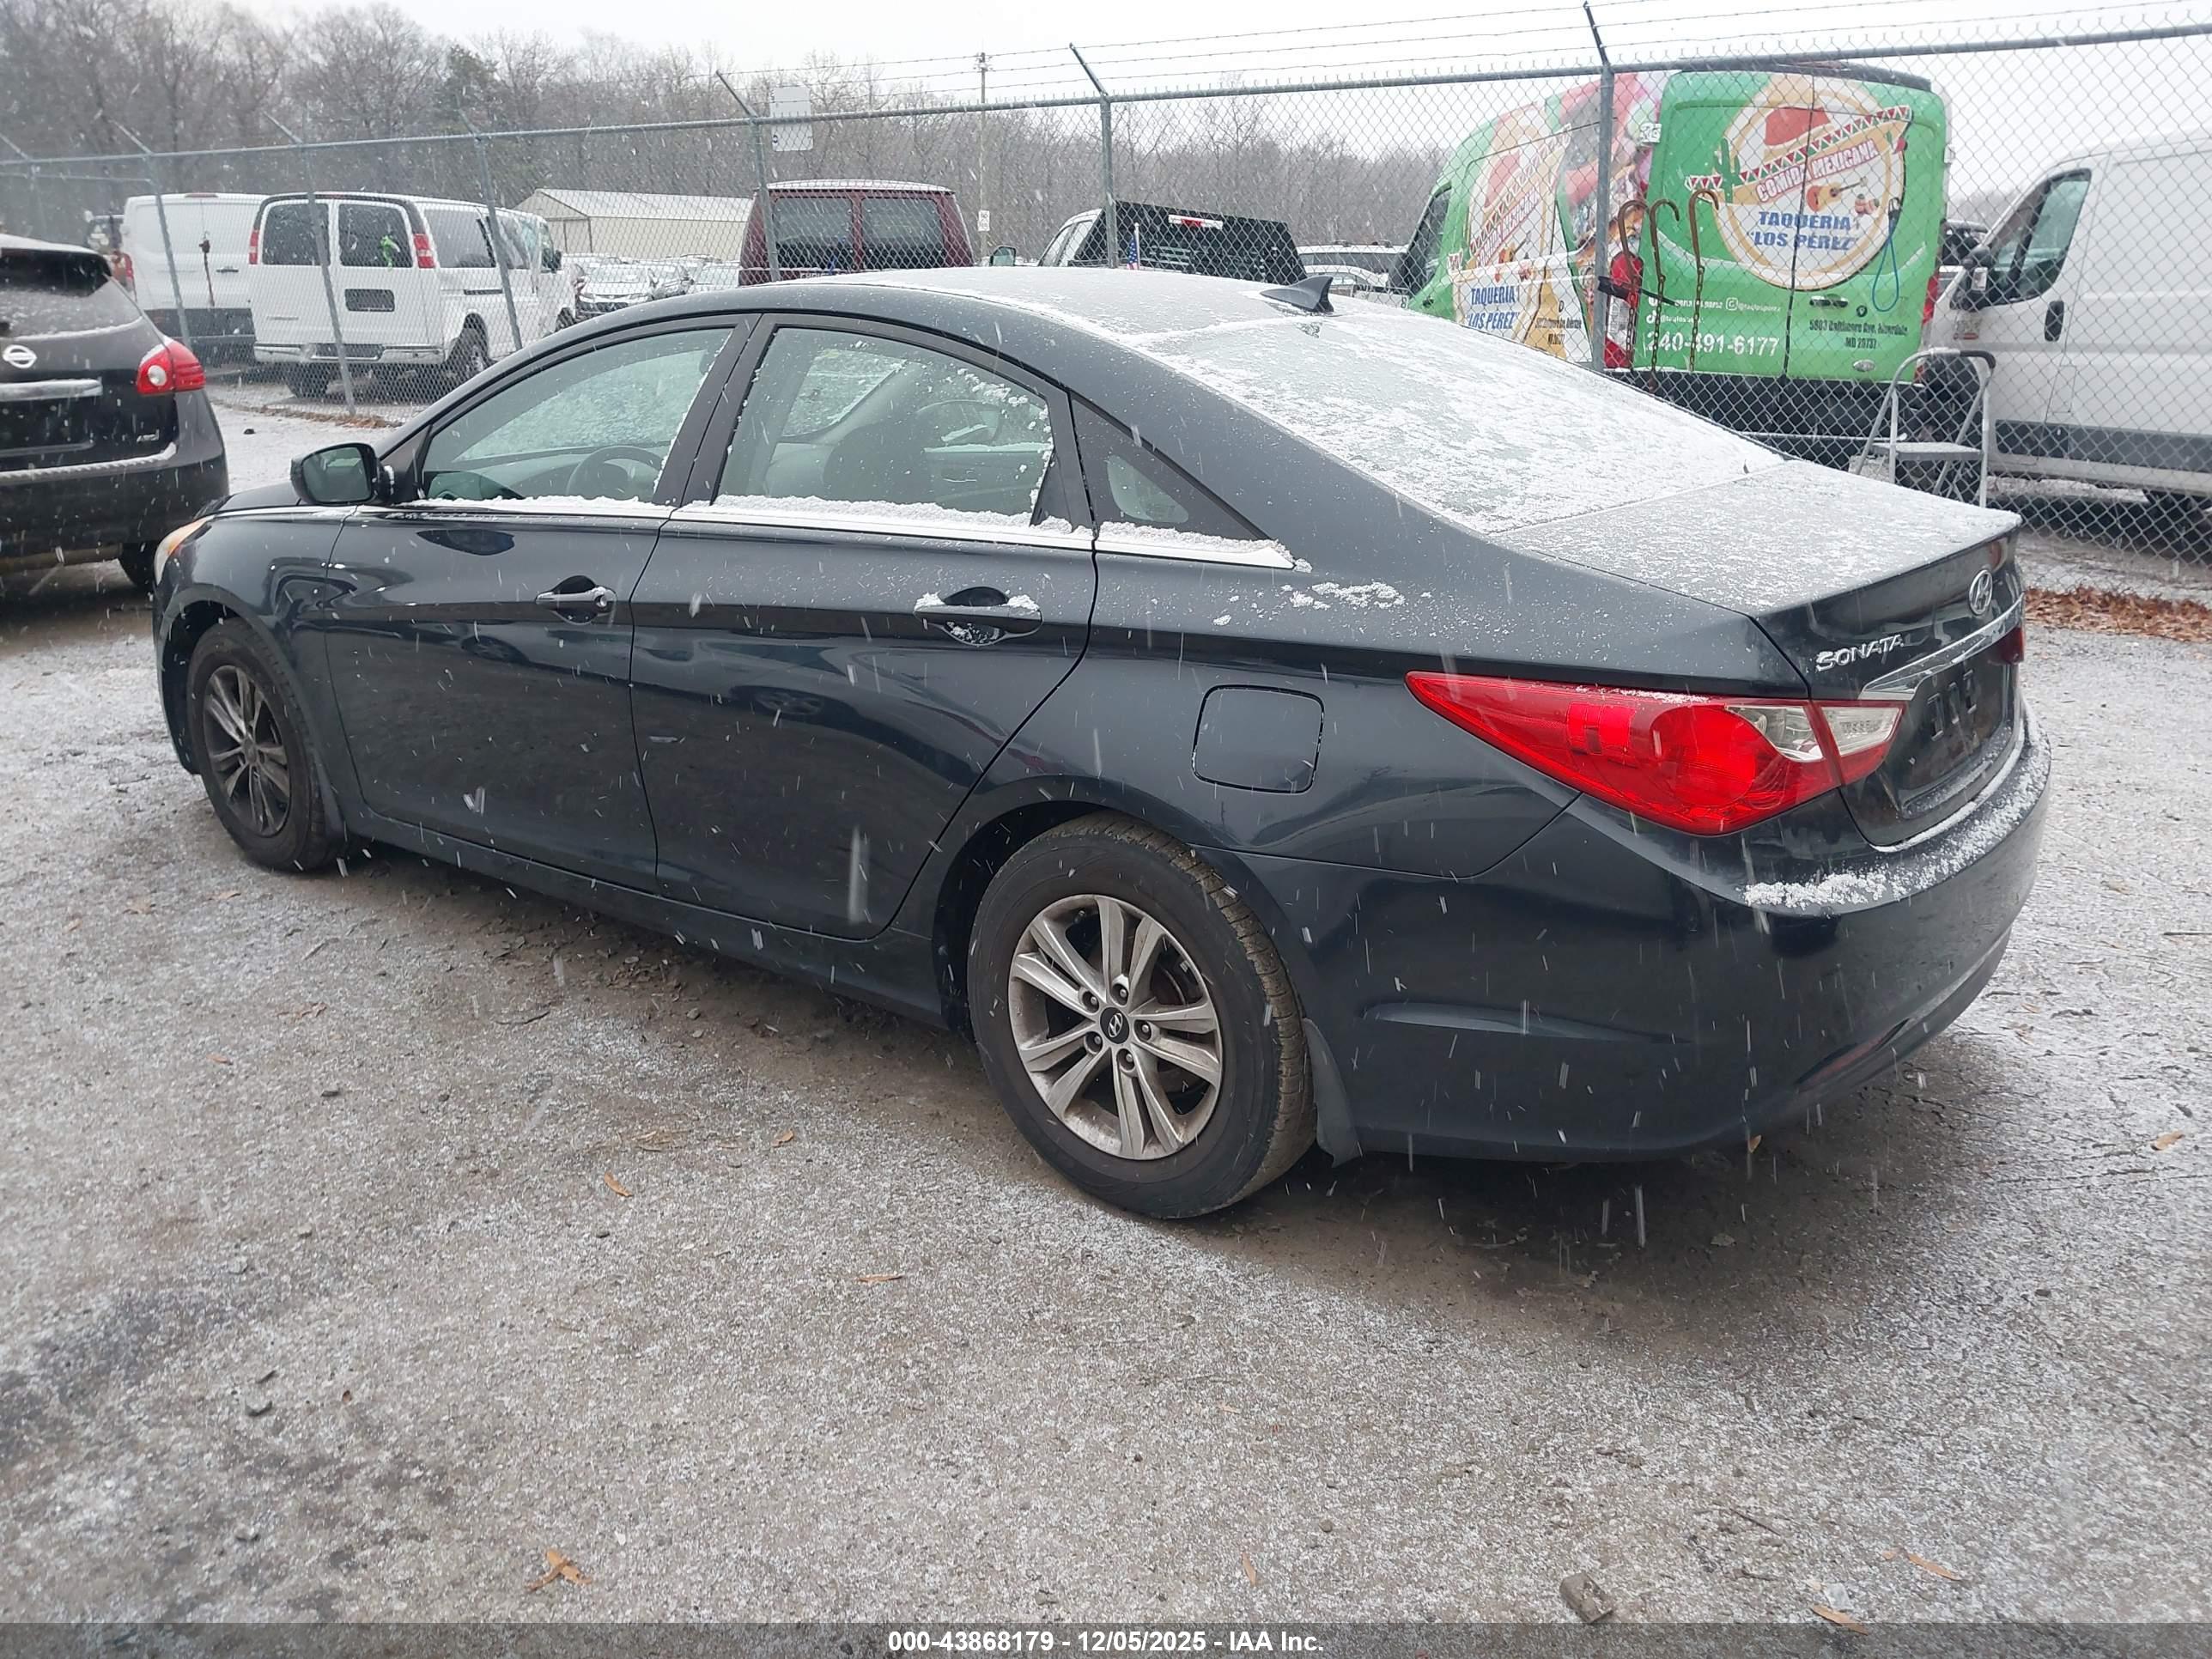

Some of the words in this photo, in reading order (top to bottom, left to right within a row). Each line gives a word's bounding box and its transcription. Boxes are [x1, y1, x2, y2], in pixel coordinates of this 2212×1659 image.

[1756, 164, 1811, 203] COMIDA
[1811, 138, 1879, 178] MEXICANA
[1758, 211, 1850, 230] TAQUERIA
[1471, 285, 1516, 306] TAQUERIA
[1646, 331, 1780, 356] 240-491-6177
[1815, 634, 1905, 672] SONATA
